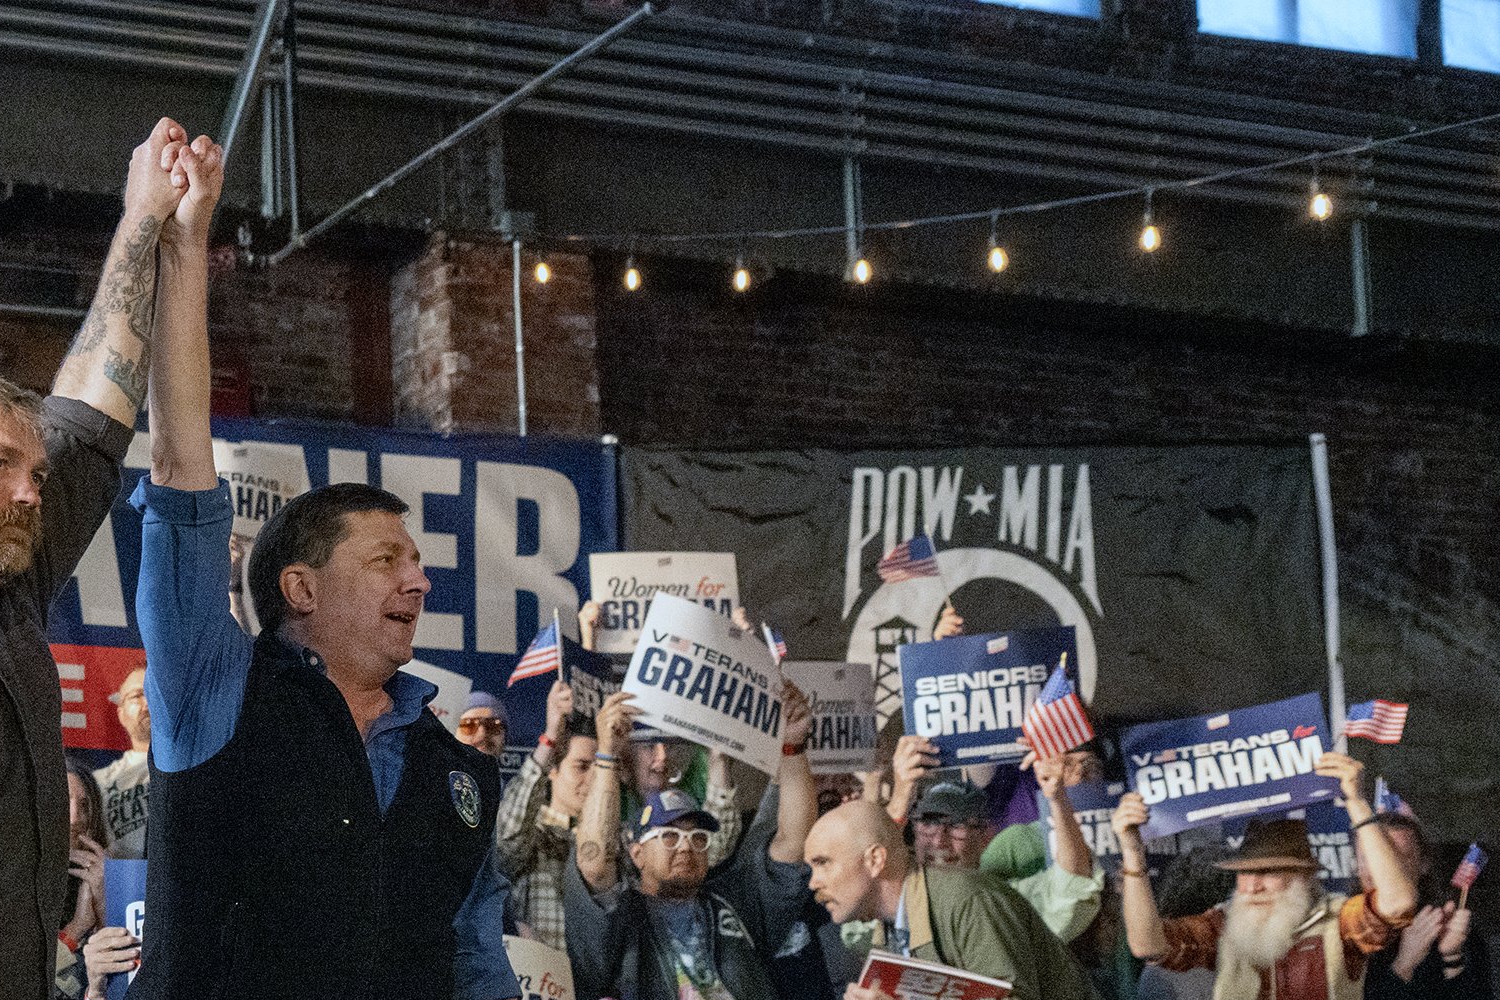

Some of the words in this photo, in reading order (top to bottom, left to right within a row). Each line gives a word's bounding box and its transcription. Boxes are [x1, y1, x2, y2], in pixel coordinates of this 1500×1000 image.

[841, 465, 963, 621] POW
[997, 463, 1104, 618] MIA
[608, 576, 690, 598] Women
[696, 576, 726, 597] for
[653, 629, 769, 690] VTERANS
[915, 664, 1047, 696] SENIORS
[637, 646, 783, 739] GRAHAM
[913, 683, 1042, 737] GRAH
[1132, 728, 1289, 766] VTERANS
[1136, 735, 1324, 805] GRAHAM
[539, 972, 567, 999] for
